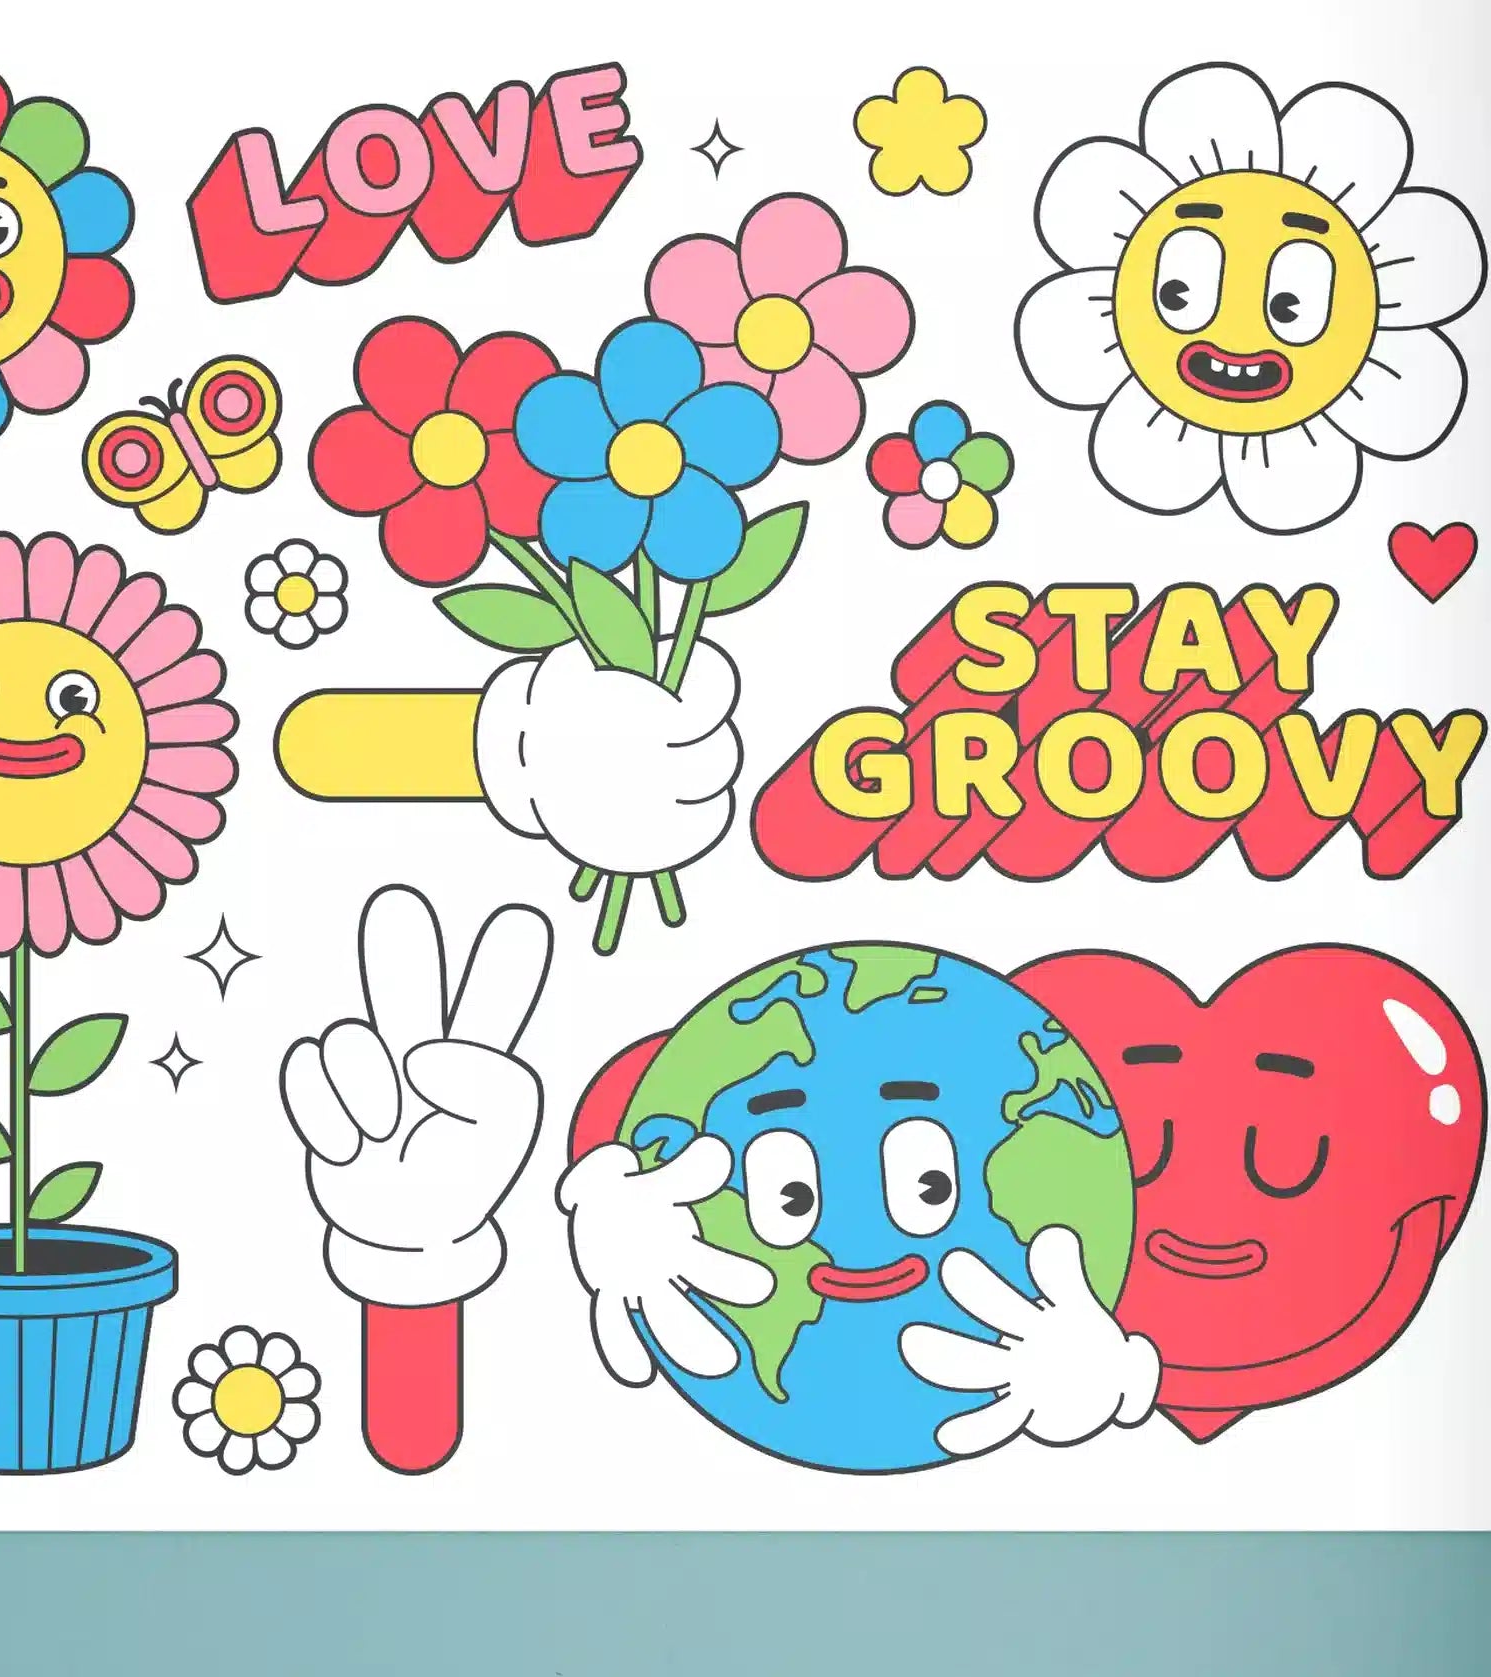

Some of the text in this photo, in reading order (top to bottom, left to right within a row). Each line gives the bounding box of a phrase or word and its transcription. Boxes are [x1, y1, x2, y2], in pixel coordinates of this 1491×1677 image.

[233, 62, 644, 236] LOVE
[951, 582, 1339, 694] STAY
[810, 706, 1488, 820] GROOVY
